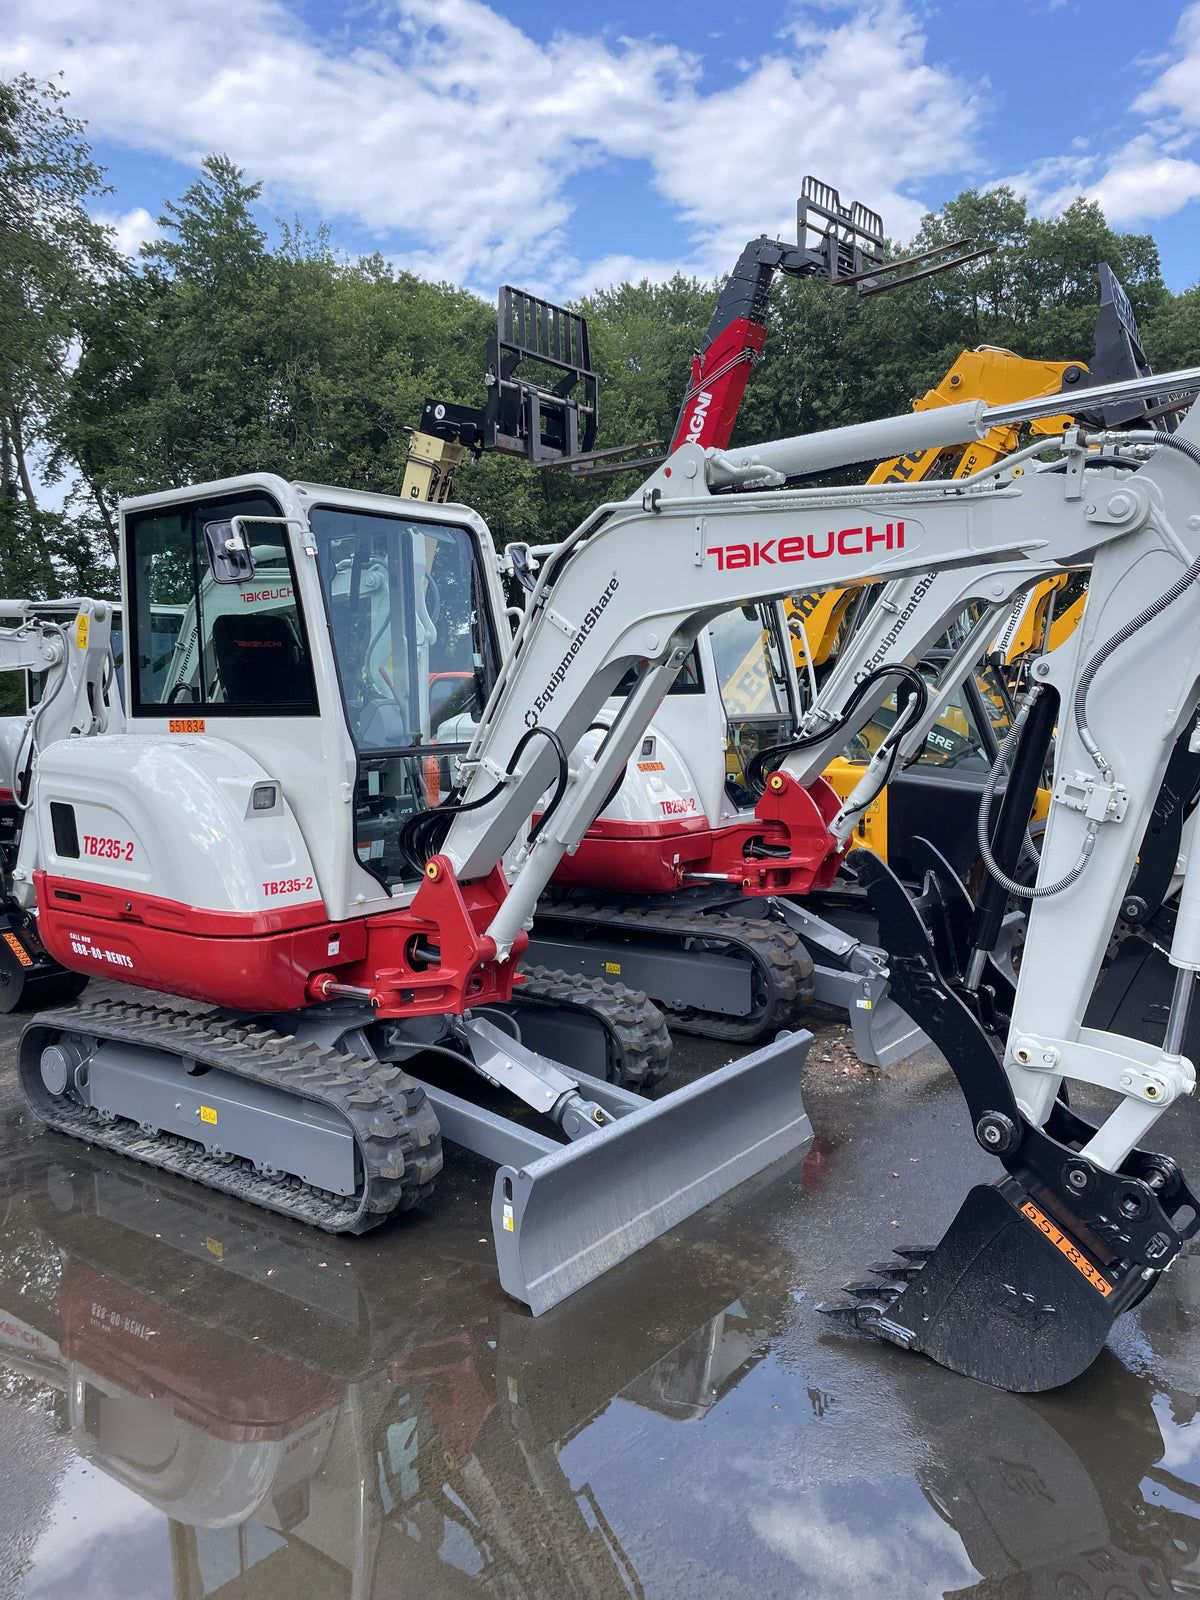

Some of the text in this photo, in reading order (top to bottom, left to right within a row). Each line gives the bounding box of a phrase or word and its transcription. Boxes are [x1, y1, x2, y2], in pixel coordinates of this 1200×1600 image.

[707, 522, 905, 570] TAKEUCHI
[534, 577, 619, 712] EquipmentShare
[168, 719, 205, 733] 551834
[660, 798, 697, 815] TB250-2
[83, 835, 134, 862] TB235-2
[262, 876, 313, 896] TB235-2
[71, 941, 134, 968] 888-80-RENTS
[1024, 1205, 1110, 1293] 551835
